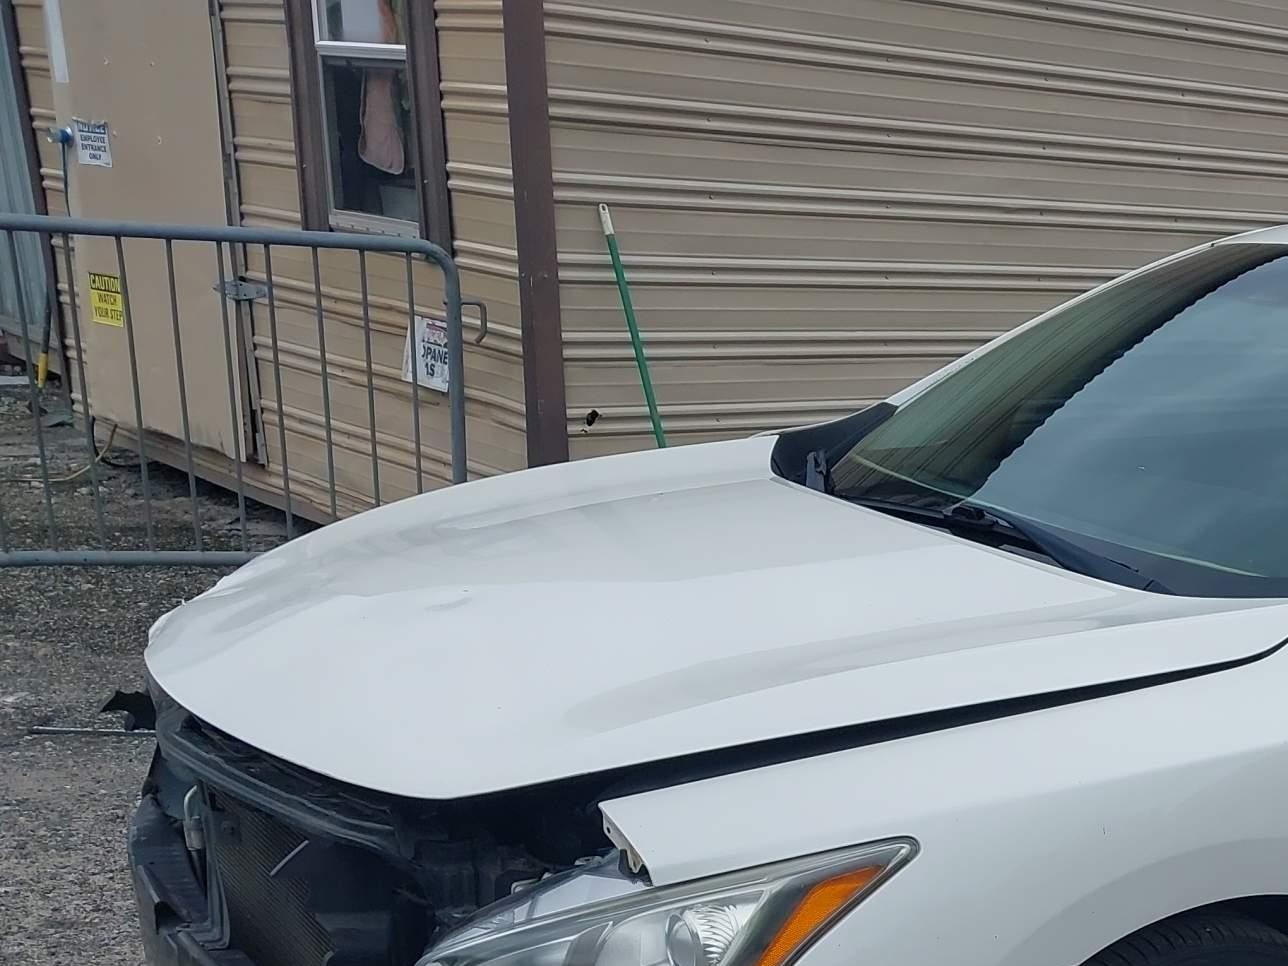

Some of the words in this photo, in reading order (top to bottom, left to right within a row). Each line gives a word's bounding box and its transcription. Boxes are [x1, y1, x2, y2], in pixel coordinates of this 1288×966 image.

[88, 152, 102, 161] ONLY
[89, 273, 120, 293] CAUTION
[97, 292, 117, 305] WATCH
[94, 306, 109, 318] YOUR
